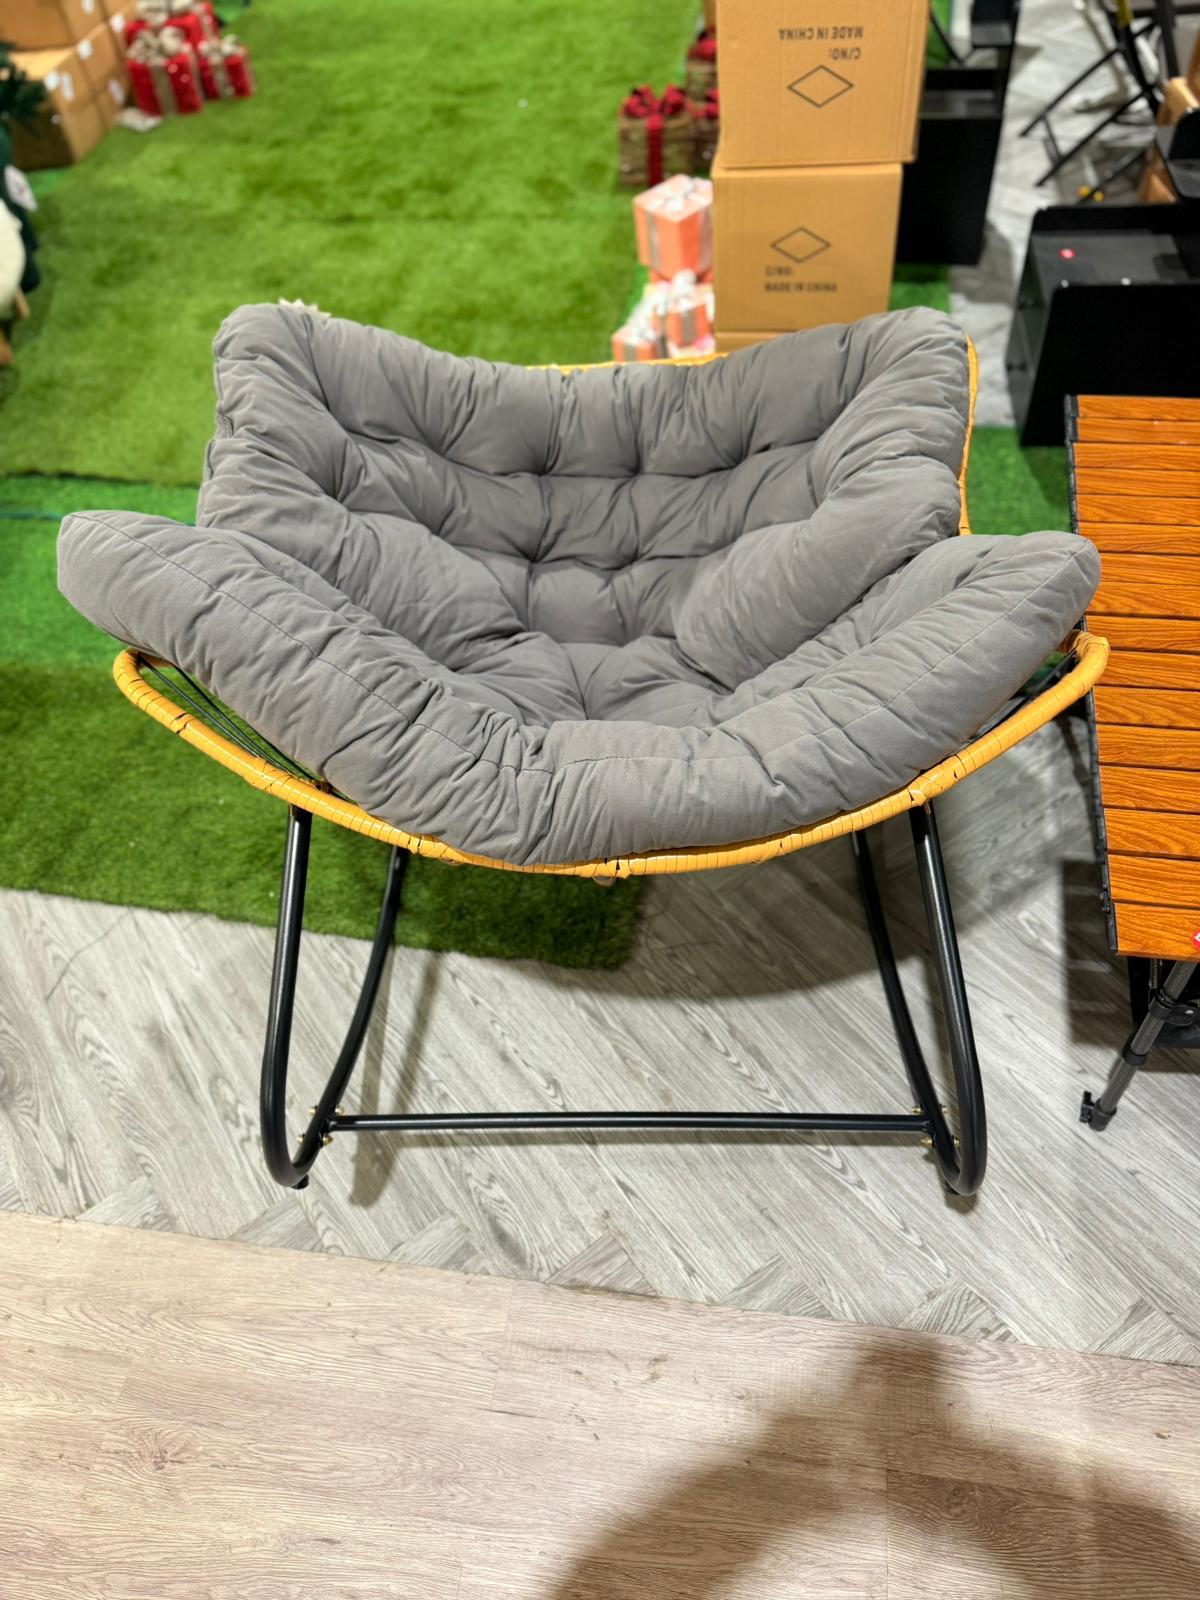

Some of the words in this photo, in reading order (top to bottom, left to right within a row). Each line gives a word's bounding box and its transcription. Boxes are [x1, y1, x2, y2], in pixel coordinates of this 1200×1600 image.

[778, 27, 814, 40] CHINA
[816, 27, 829, 39] IN
[831, 26, 864, 39] MADE
[765, 282, 791, 292] MADE
[795, 282, 804, 292] IN
[807, 282, 838, 293] CHINA
